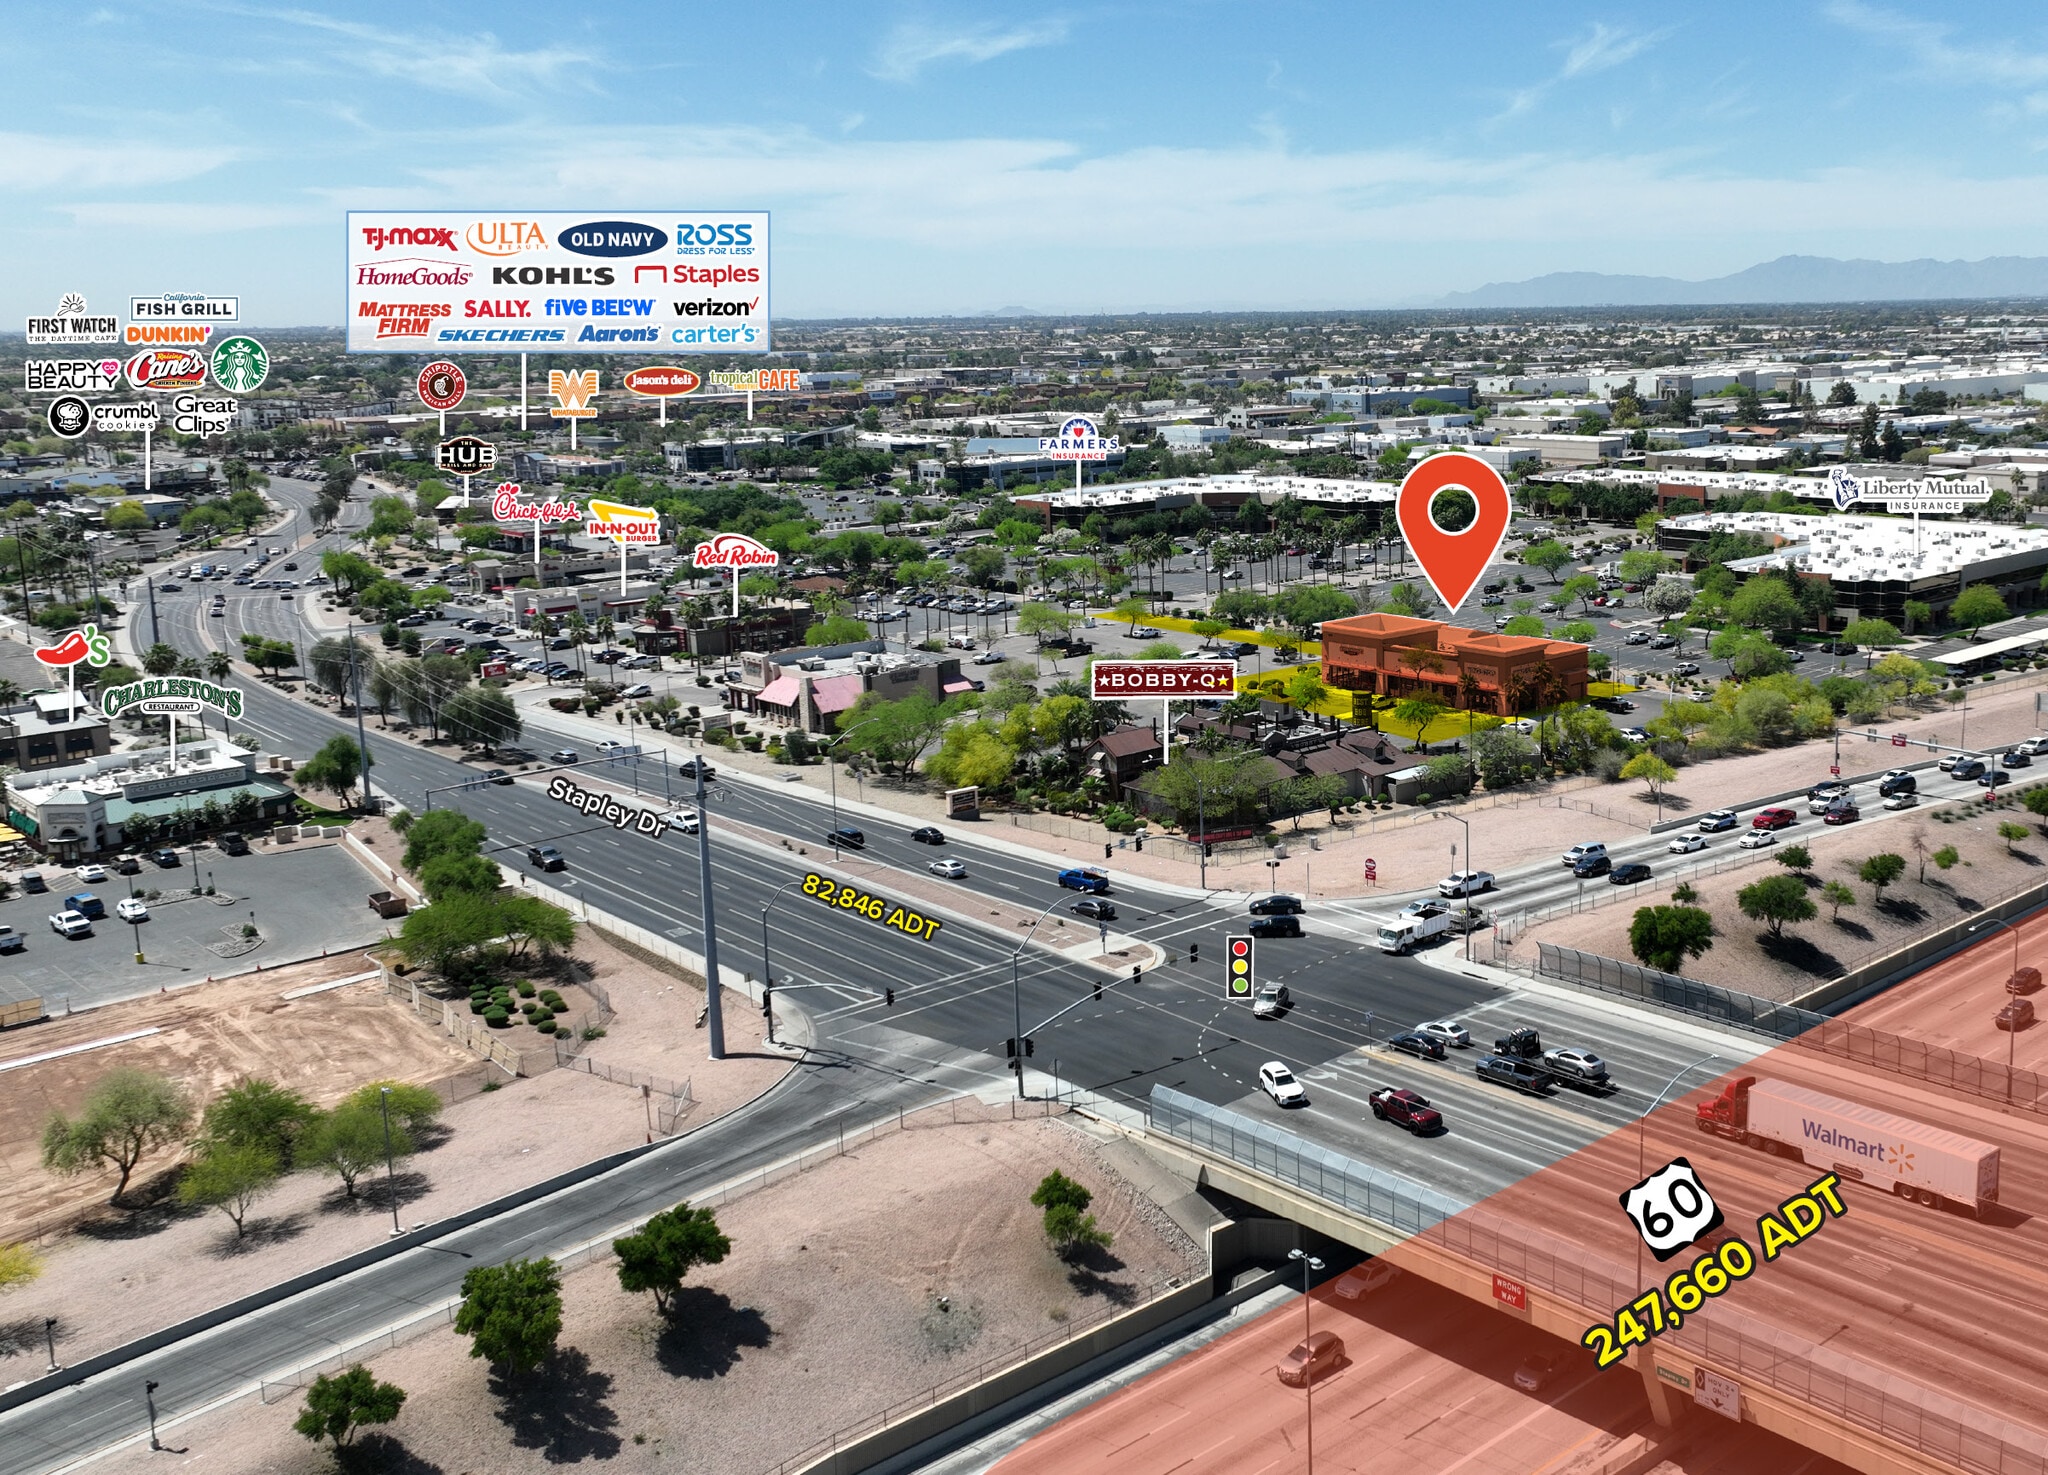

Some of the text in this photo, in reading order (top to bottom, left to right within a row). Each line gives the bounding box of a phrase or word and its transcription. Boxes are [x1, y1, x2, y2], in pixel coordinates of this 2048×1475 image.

[1802, 1118, 1885, 1162] Walmart
[1496, 1278, 1521, 1296] WRONG
[1501, 1290, 1517, 1304] WAY
